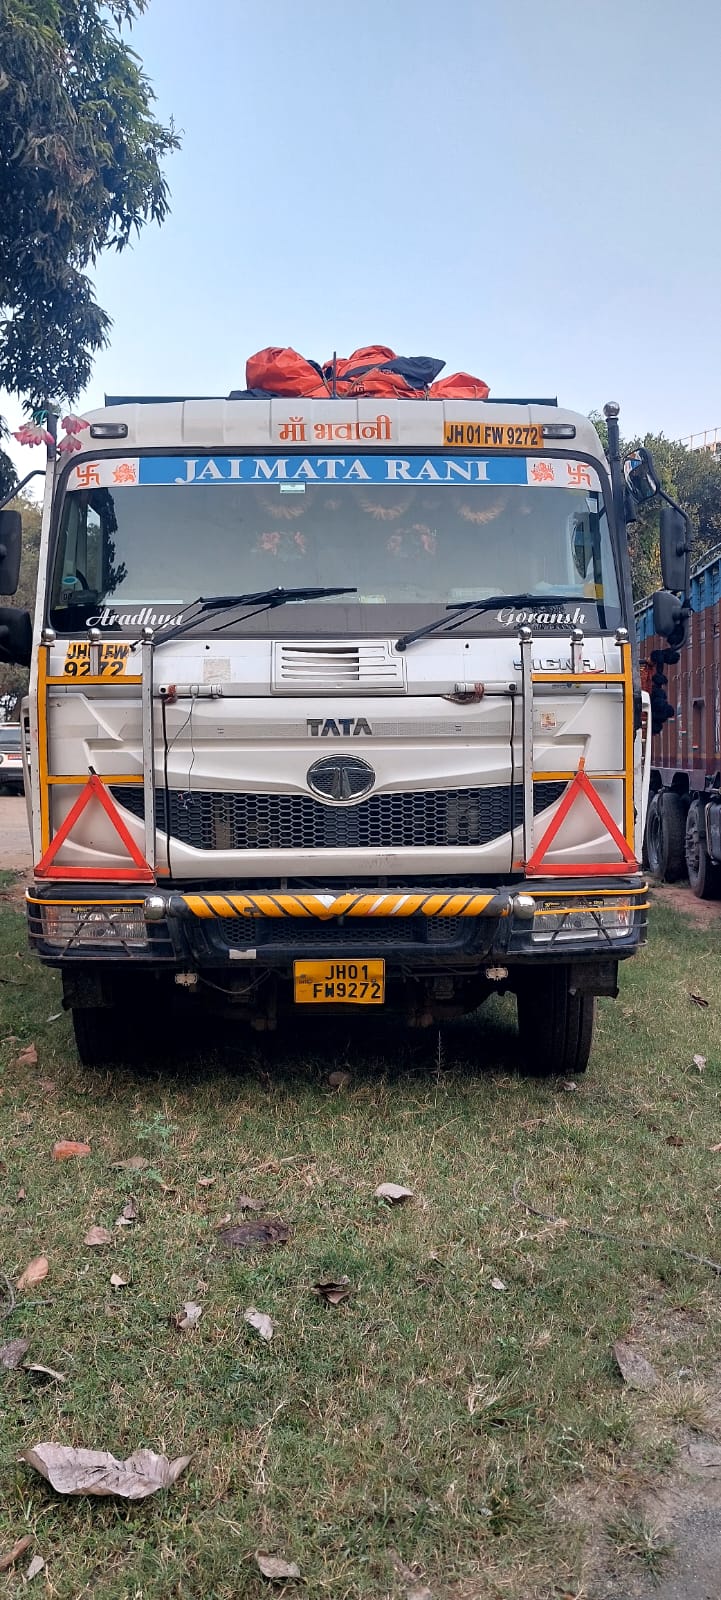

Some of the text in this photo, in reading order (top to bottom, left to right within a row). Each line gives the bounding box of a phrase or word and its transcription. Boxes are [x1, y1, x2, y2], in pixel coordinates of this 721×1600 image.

[278, 415, 392, 441] माँ भवानी
[446, 424, 538, 445] JH 01 FW 9272
[175, 459, 490, 484] JAI MATA RANI
[85, 607, 183, 628] Aradhya
[306, 717, 373, 736] TATA
[325, 964, 368, 980] JH01
[313, 982, 381, 999] FW9272
